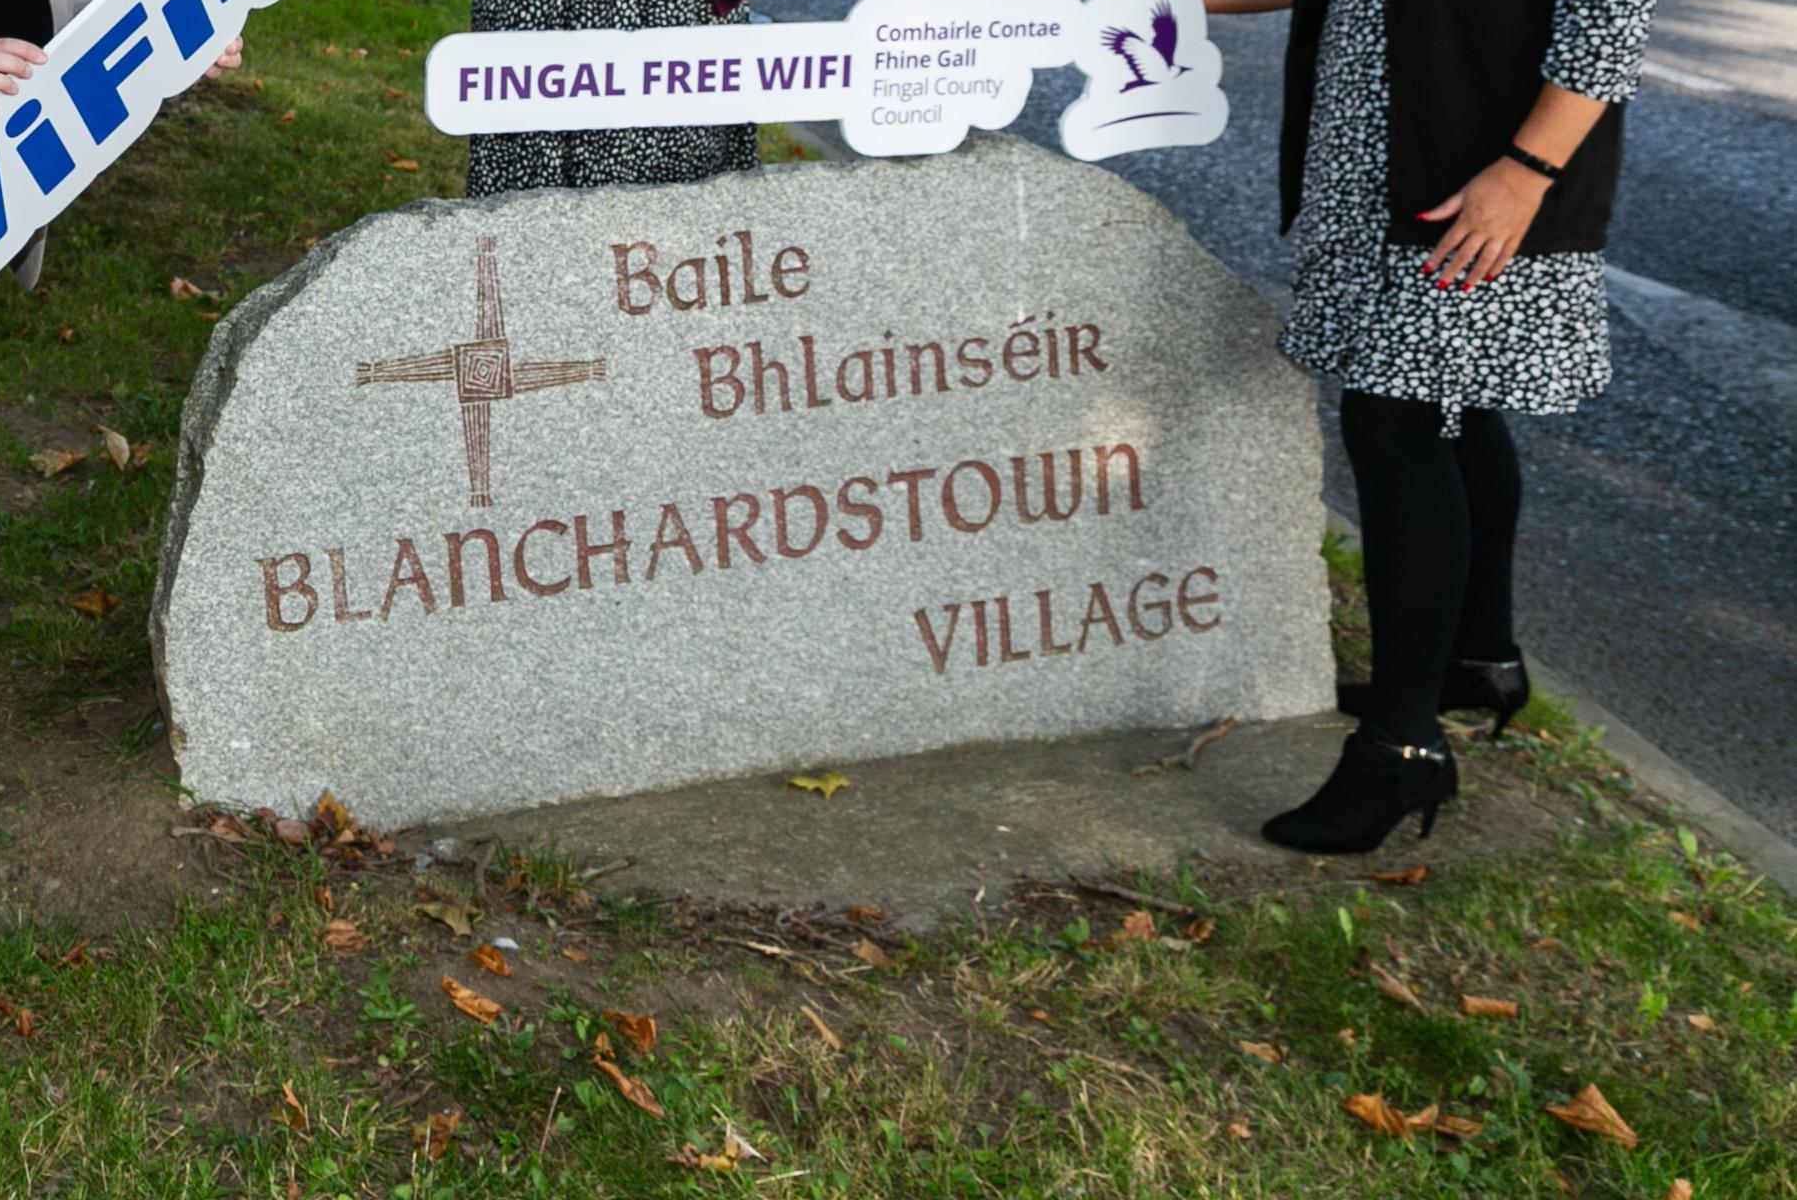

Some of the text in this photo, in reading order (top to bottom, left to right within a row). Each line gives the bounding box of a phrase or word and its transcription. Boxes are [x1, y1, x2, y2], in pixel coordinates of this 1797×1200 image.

[876, 21, 1060, 42] Comhairle Contae
[875, 49, 976, 69] Fhine Gall
[460, 55, 851, 102] FINGAL FREE WIFI
[873, 75, 1004, 102] Fingal County
[871, 104, 943, 126] Council
[611, 230, 811, 318] Baile
[258, 442, 1146, 634] BLANCHARDSTOWN
[913, 566, 1219, 676] VILLAGE
